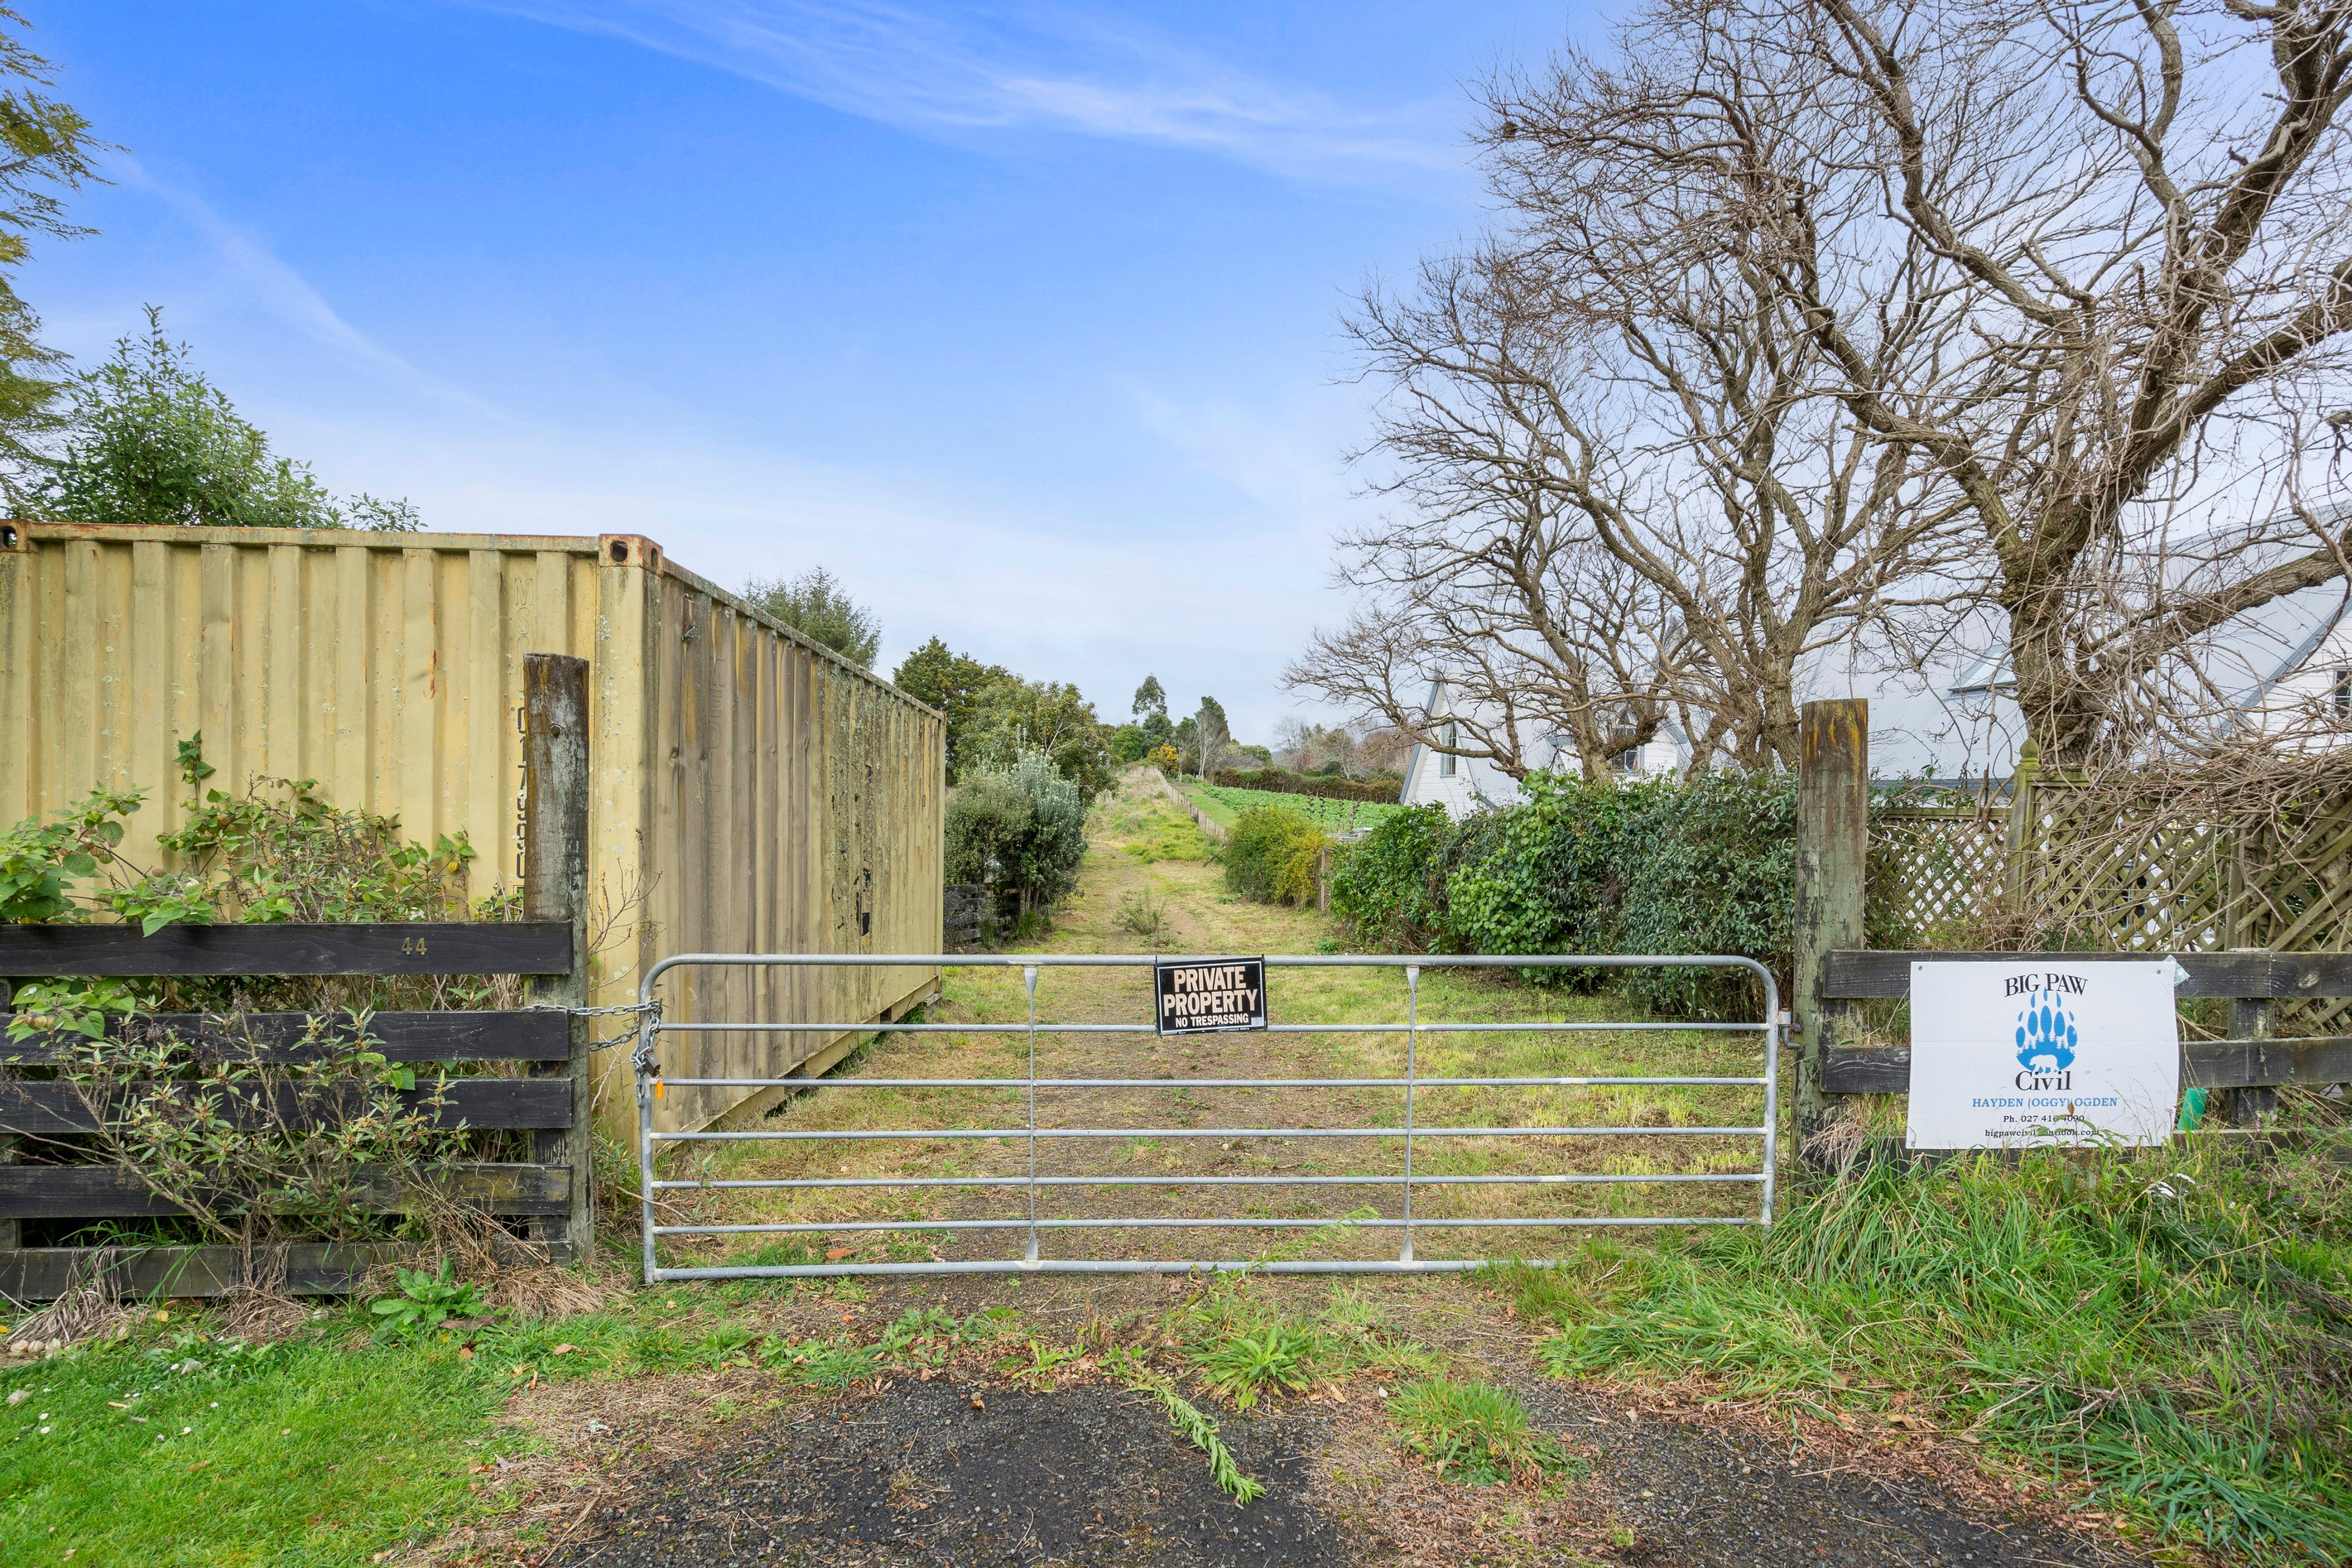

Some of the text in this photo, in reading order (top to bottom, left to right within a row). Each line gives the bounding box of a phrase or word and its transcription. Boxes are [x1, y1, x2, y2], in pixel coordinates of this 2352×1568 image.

[401, 937, 427, 955] 44
[1173, 965, 1247, 993] PRIVATE
[2003, 973, 2089, 998] BIG PAW
[1163, 988, 1258, 1017] PROPERTY
[1176, 1012, 1249, 1028] NO TRESPASSING
[2015, 1070, 2072, 1091] Civil
[1972, 1097, 2119, 1109] HAYDEN (OGGY) OGDEN
